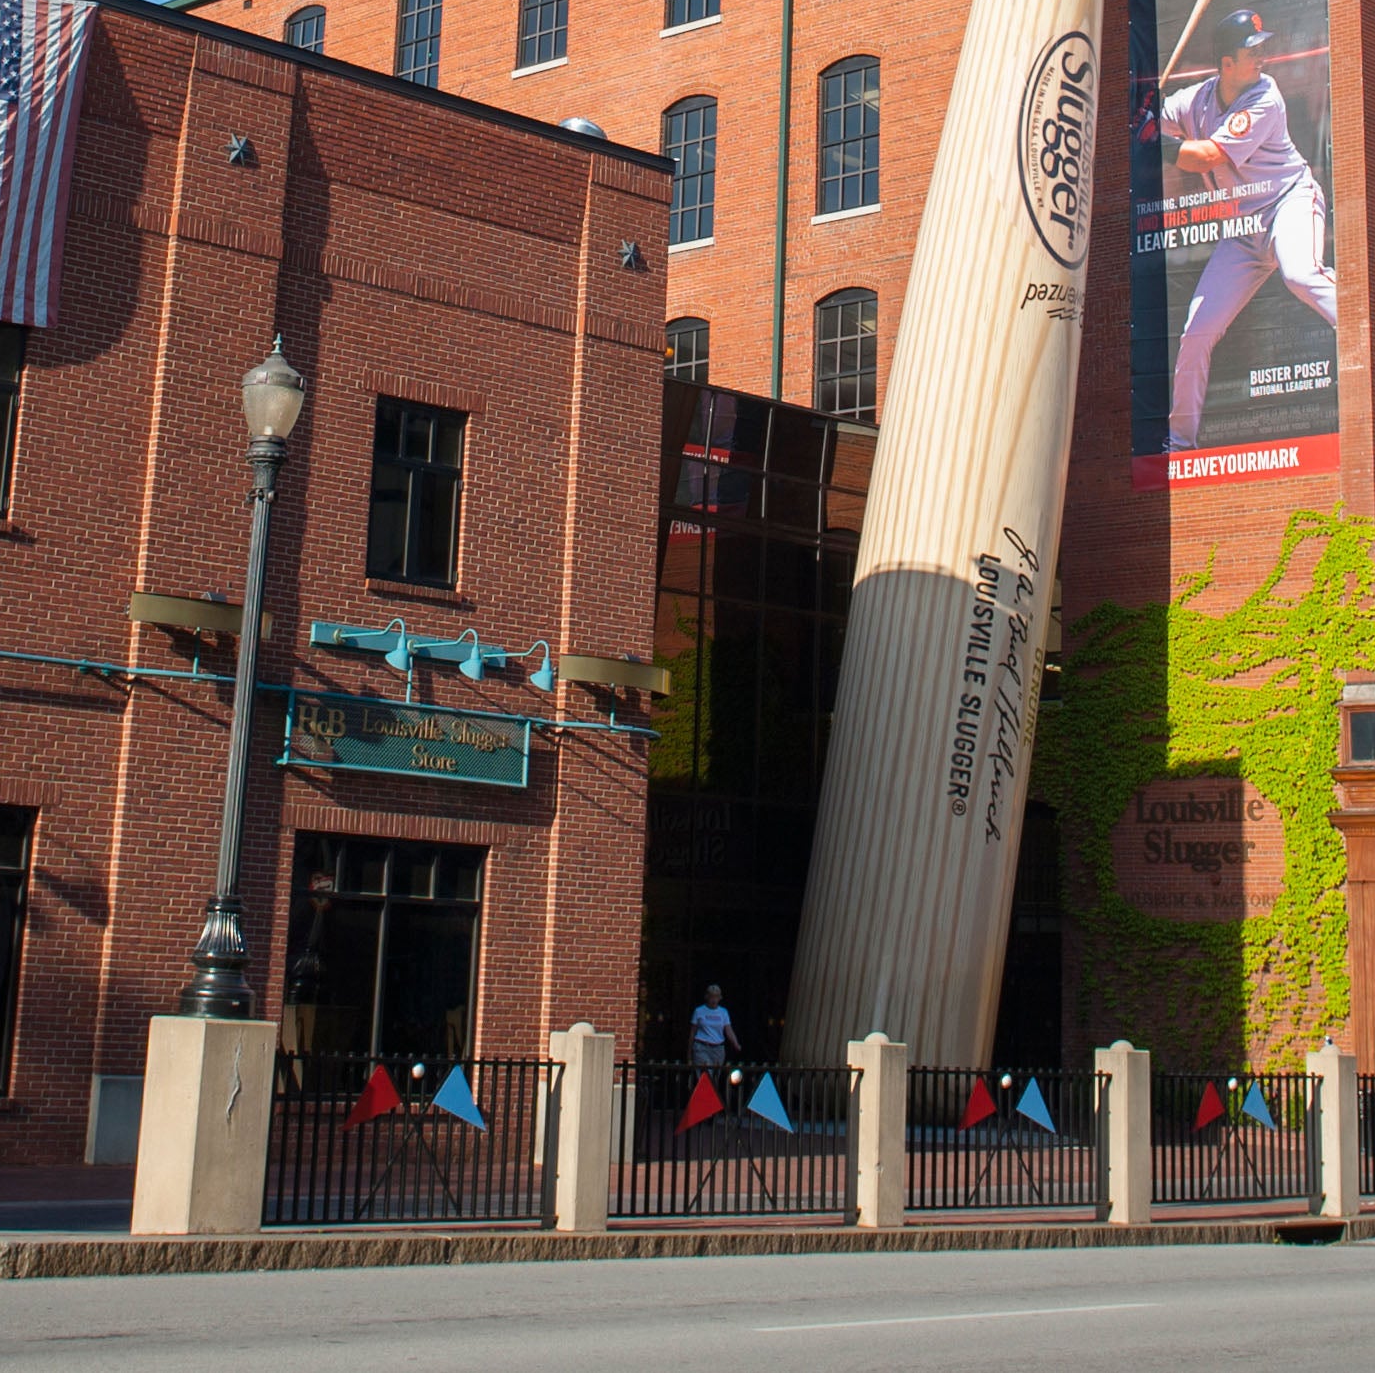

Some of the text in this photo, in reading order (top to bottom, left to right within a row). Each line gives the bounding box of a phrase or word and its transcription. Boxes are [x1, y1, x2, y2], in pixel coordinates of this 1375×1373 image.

[1040, 89, 1047, 97] IN
[1042, 67, 1055, 87] MADE
[1034, 97, 1044, 115] THE
[1040, 51, 1094, 241] Slugger
[1077, 107, 1093, 236] LOUISVILLE
[1037, 197, 1044, 208] KY
[1136, 179, 1274, 215] TRAINING. DISCIPLINE. INSTINCT.
[1137, 216, 1159, 230] AND
[1163, 211, 1188, 228] THIS
[1137, 213, 1267, 253] LEAVE YOUR MARK.
[1250, 360, 1330, 386] BUSTER POSEY
[1250, 377, 1331, 397] NATIONAL LEAGUE MVP
[1167, 447, 1300, 480] #LEAVEYOURMARK
[964, 553, 1001, 686] LOUISVILLE
[1023, 648, 1043, 748] GENUINE
[362, 707, 511, 752] Louisville Slugger
[410, 744, 457, 772] Store
[1135, 788, 1265, 823] Louisville
[1143, 828, 1256, 873] Slugger
